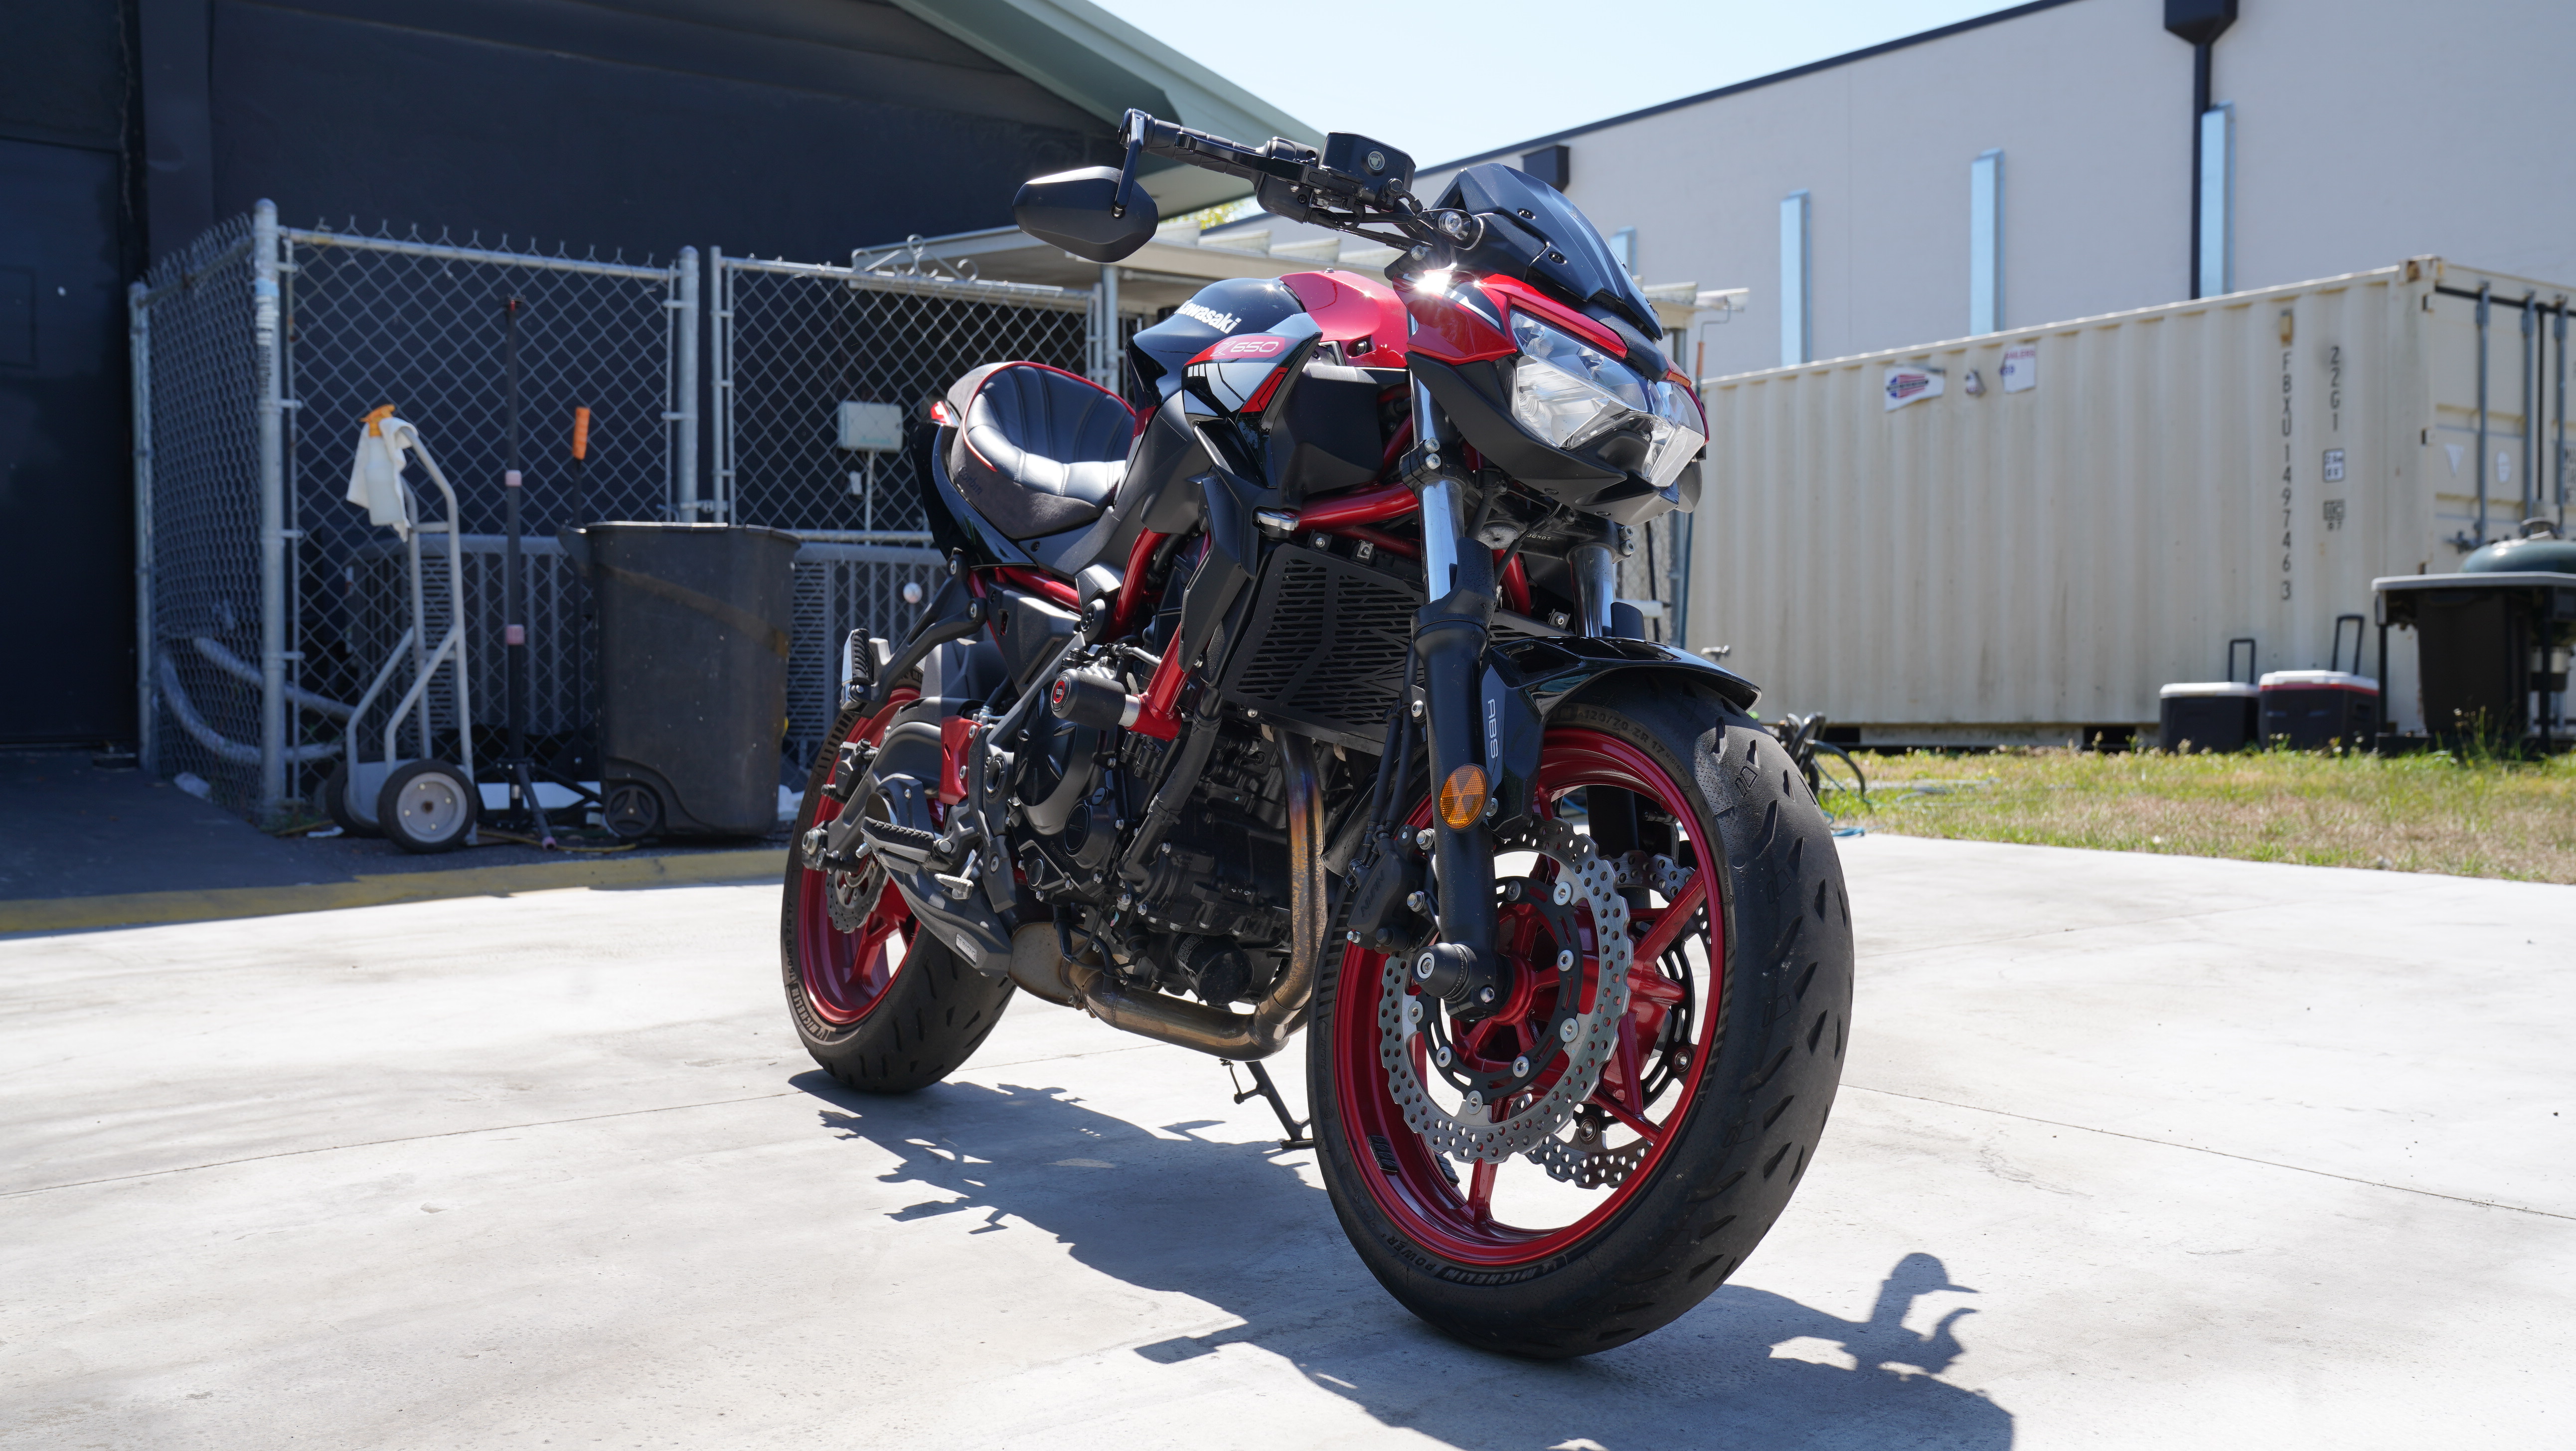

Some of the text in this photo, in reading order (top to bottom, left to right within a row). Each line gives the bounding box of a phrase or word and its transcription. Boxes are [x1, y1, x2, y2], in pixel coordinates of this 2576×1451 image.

[1174, 299, 1242, 334] Kawasaki
[2281, 352, 2292, 436] FBXU
[2329, 345, 2341, 430] 22G1
[1487, 698, 1499, 759] ABS
[1584, 710, 1629, 730] 120/70
[1631, 727, 1649, 743] ZR
[1650, 741, 1665, 753] 17
[786, 919, 793, 936] ZR
[787, 902, 794, 915] 17
[791, 988, 820, 1037] MICHELIN
[1387, 1236, 1437, 1272] POWER
[1444, 1267, 1538, 1285] MICHELIN
